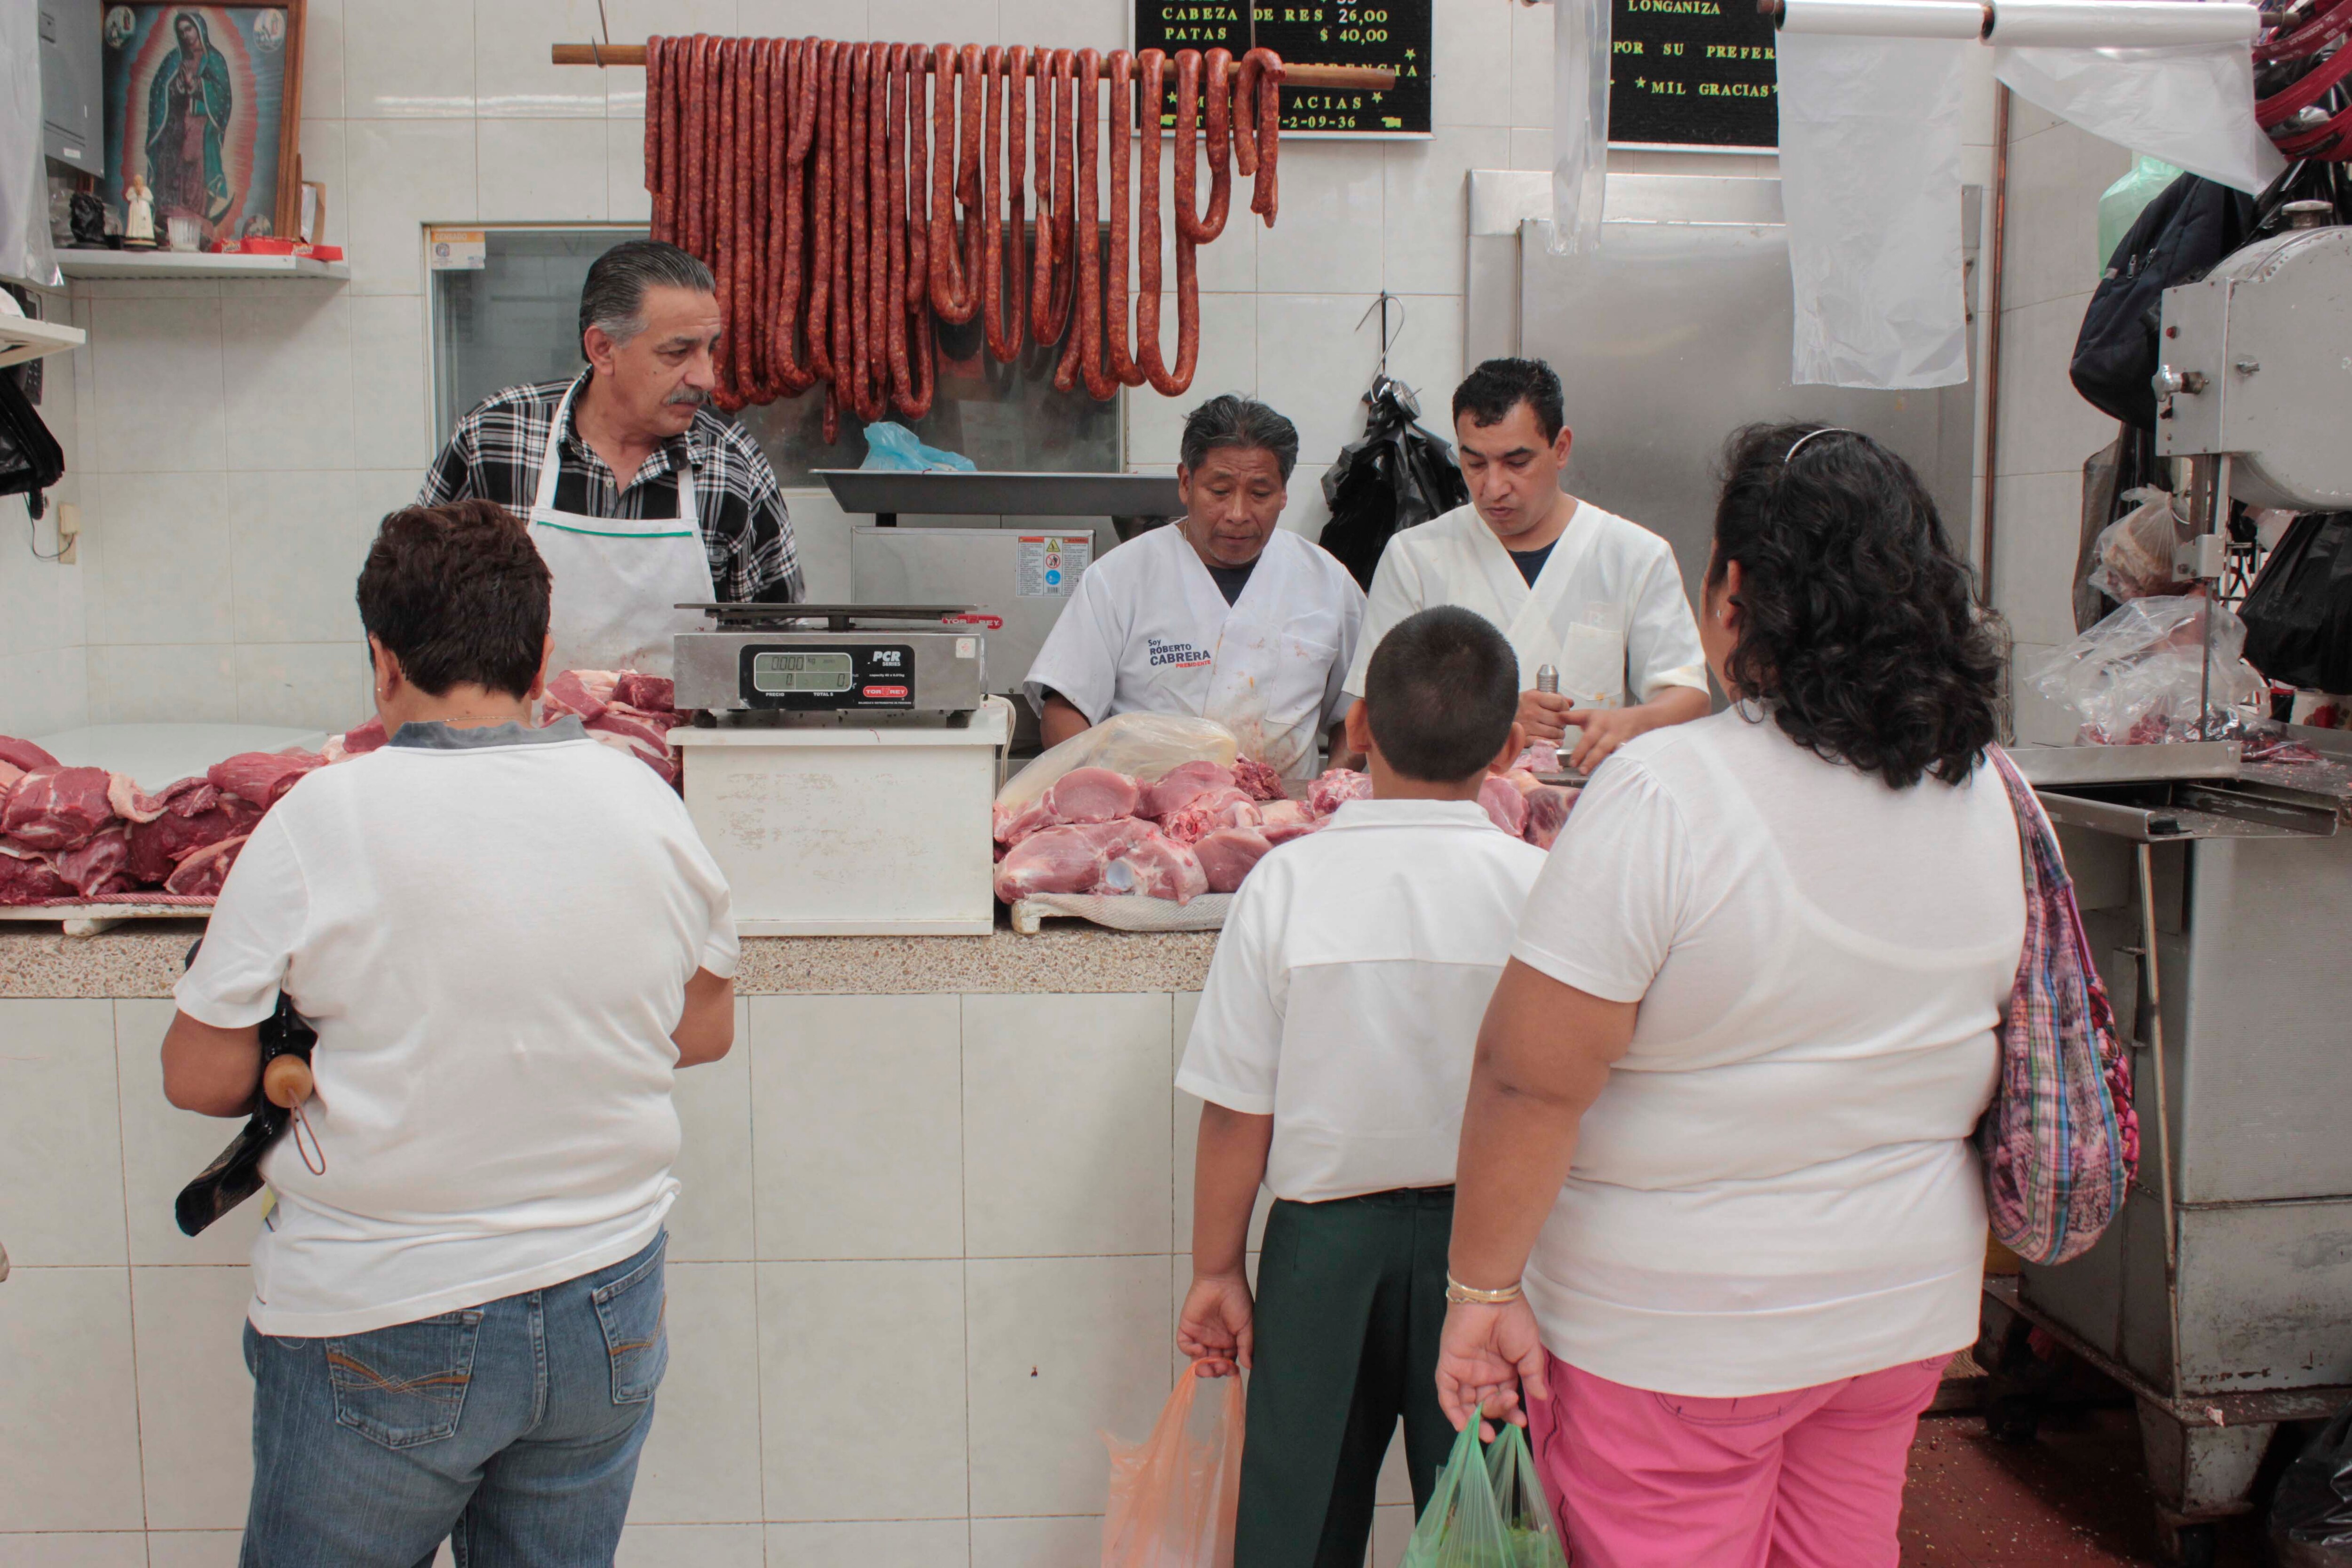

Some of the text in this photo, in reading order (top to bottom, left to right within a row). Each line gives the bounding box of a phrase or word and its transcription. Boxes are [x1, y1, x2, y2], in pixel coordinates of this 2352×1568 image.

[1628, 0, 1720, 15] LONGANIZA
[1162, 8, 1388, 26] CABEZA DE RES 26,00
[1165, 27, 1388, 45] PATAS $ 40,00
[1613, 41, 1775, 59] POR SU PREFER
[1652, 82, 1768, 97] MIL GRACIAS
[1293, 96, 1361, 109] ACIAS
[1278, 116, 1355, 128] -2-09-36
[873, 651, 901, 662] PCR
[1150, 644, 1192, 655] ROBERTO
[1150, 650, 1211, 666] CABRERA
[1176, 660, 1211, 668] PRESIDENTE
[837, 673, 845, 686] 0
